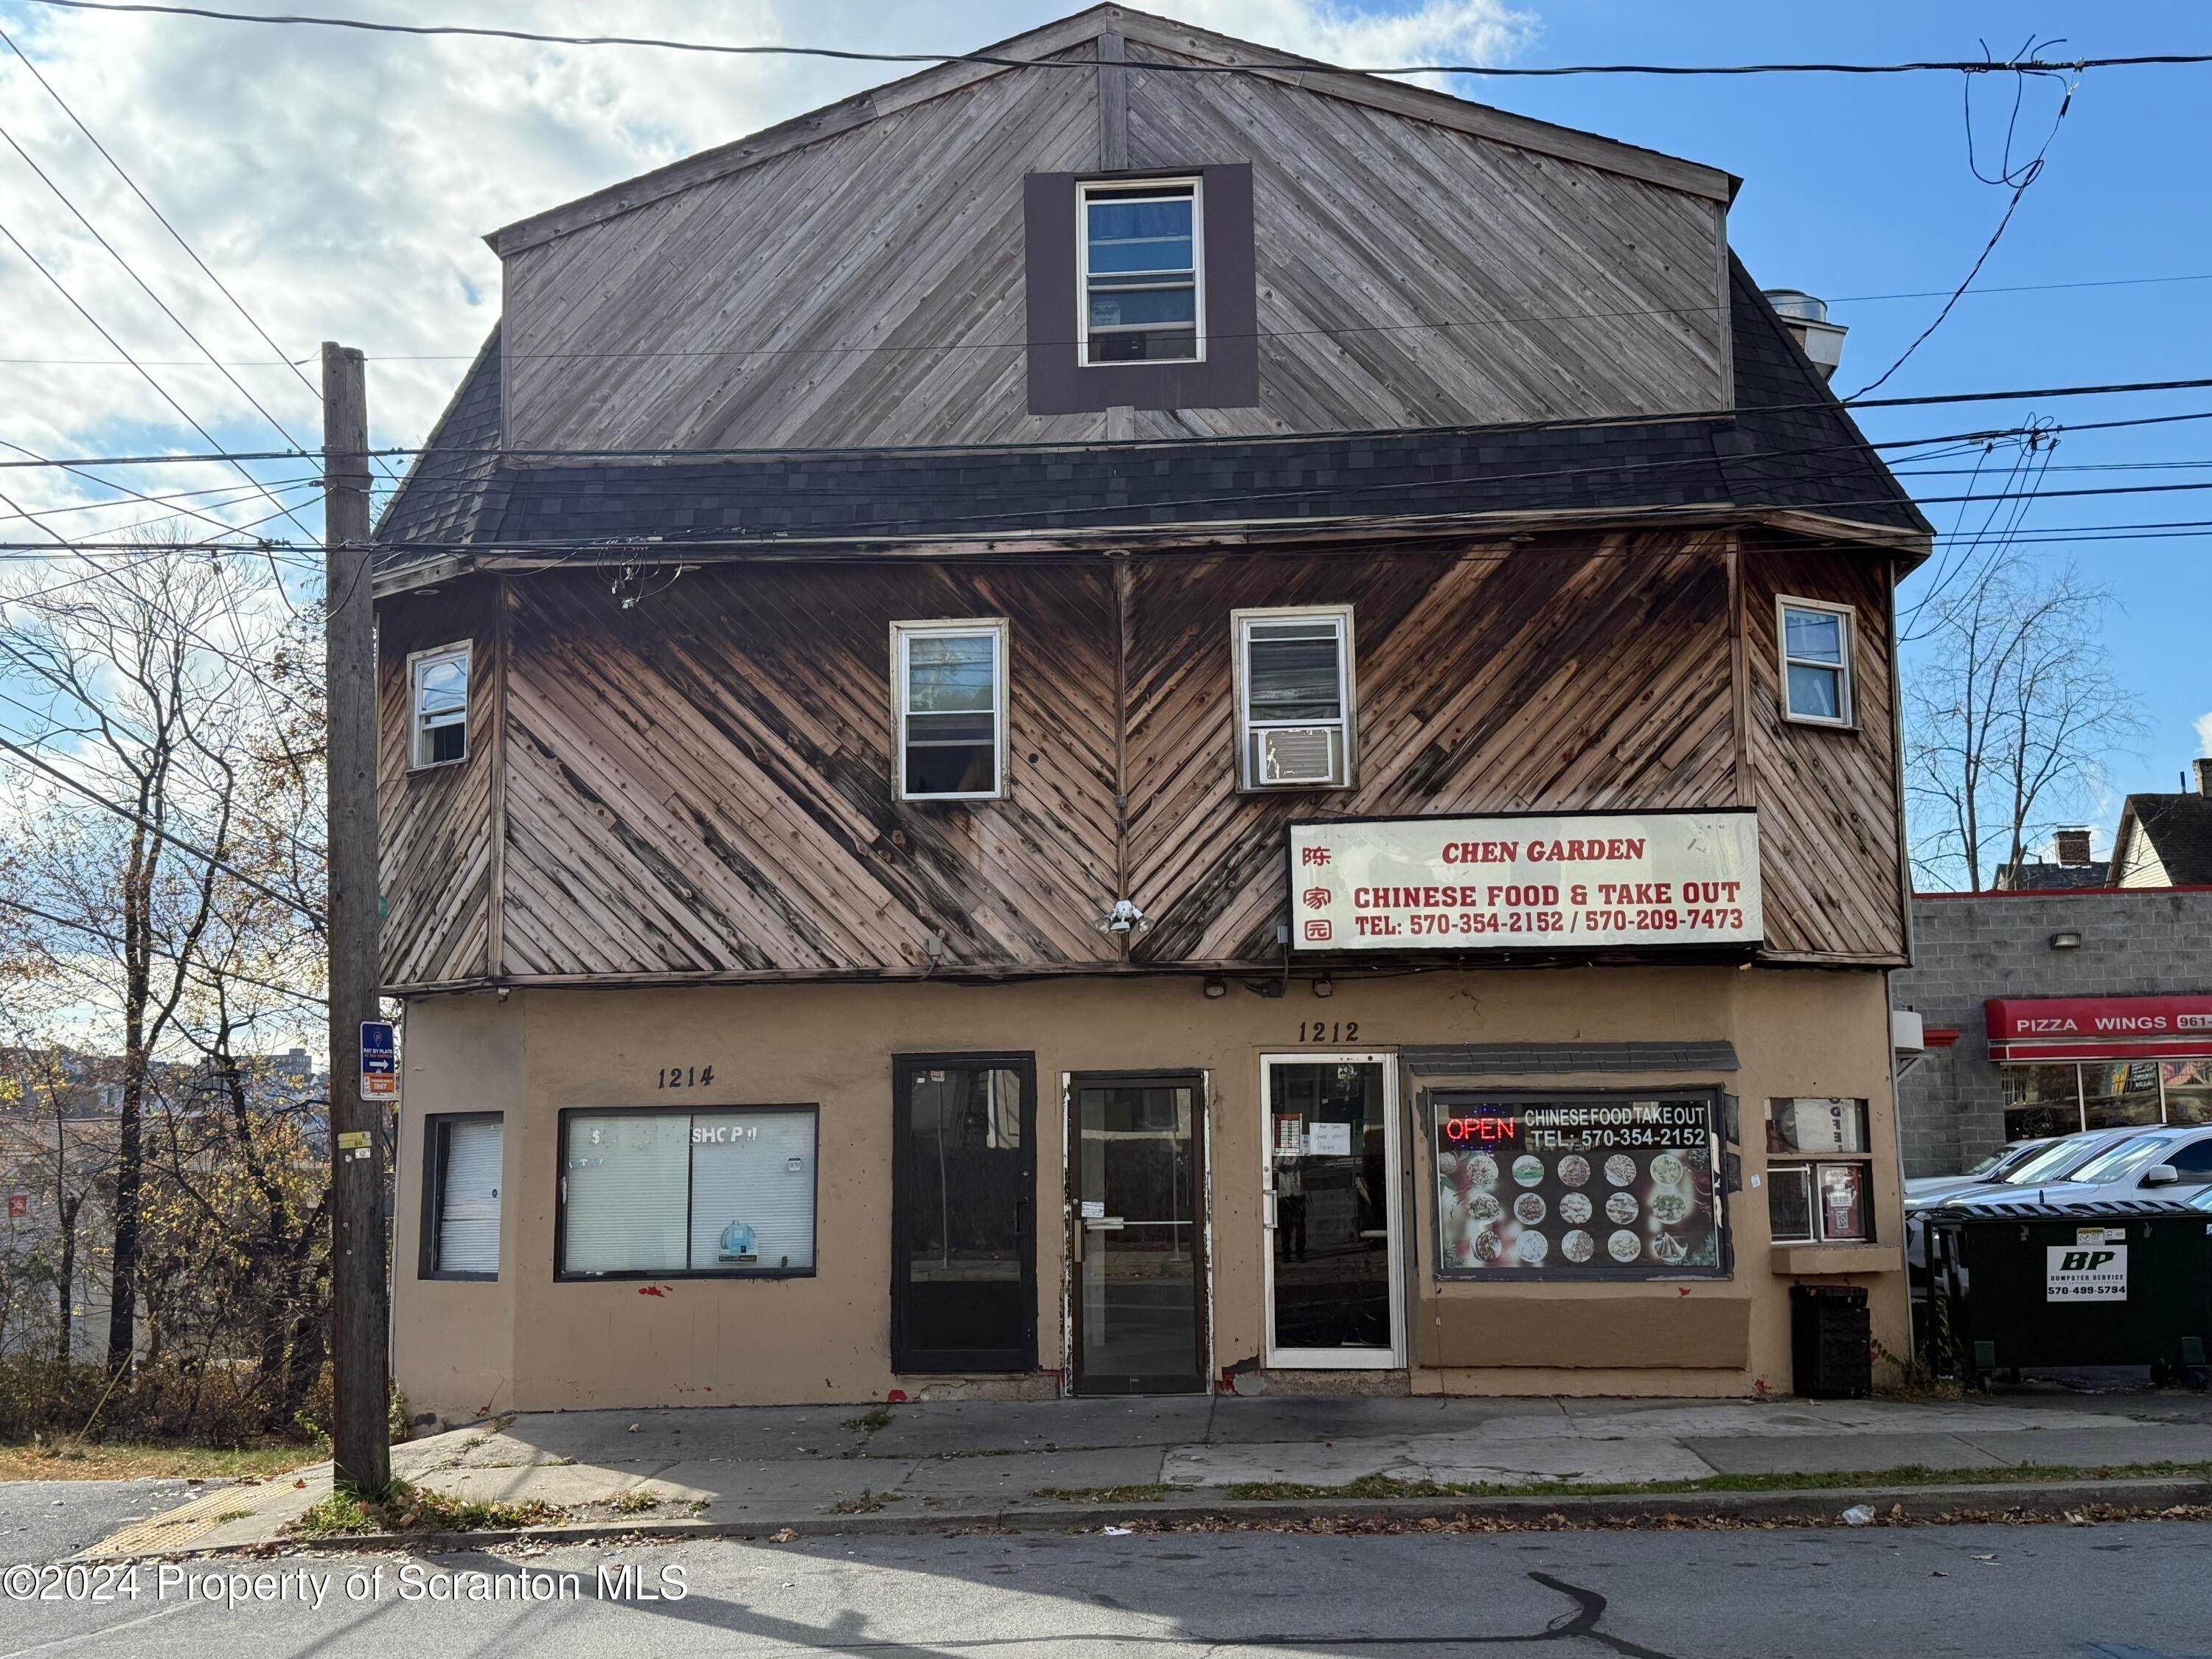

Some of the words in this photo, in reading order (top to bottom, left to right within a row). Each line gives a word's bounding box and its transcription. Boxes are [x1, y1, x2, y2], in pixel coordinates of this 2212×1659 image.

[1441, 841, 1519, 864] CHEN
[1526, 838, 1646, 863] GARDEN
[1354, 886, 1477, 908] CHINESE
[1487, 885, 1560, 907] FOOD
[1571, 885, 1588, 905] &
[1598, 883, 1672, 905] TAKE
[1682, 881, 1741, 904] OUT
[1355, 915, 1402, 936] TEL:
[1410, 911, 1563, 935] 570-354-2152
[1585, 909, 1743, 931] 570-209-7473
[1298, 1021, 1359, 1043] 1212
[2017, 1018, 2078, 1032] PIZZA
[2095, 1016, 2168, 1030] WINGS
[658, 1065, 714, 1090] 1214
[1524, 1108, 1589, 1127] CHINESE
[1590, 1107, 1632, 1125] FOOD
[1632, 1107, 1673, 1125] TAKE
[1673, 1107, 1705, 1124] OUT
[1446, 1117, 1514, 1141] OPEN
[1581, 1128, 1705, 1147] 570-354-2152
[2059, 1251, 2116, 1271] BP
[2048, 1285, 2126, 1295] 570-499-5794
